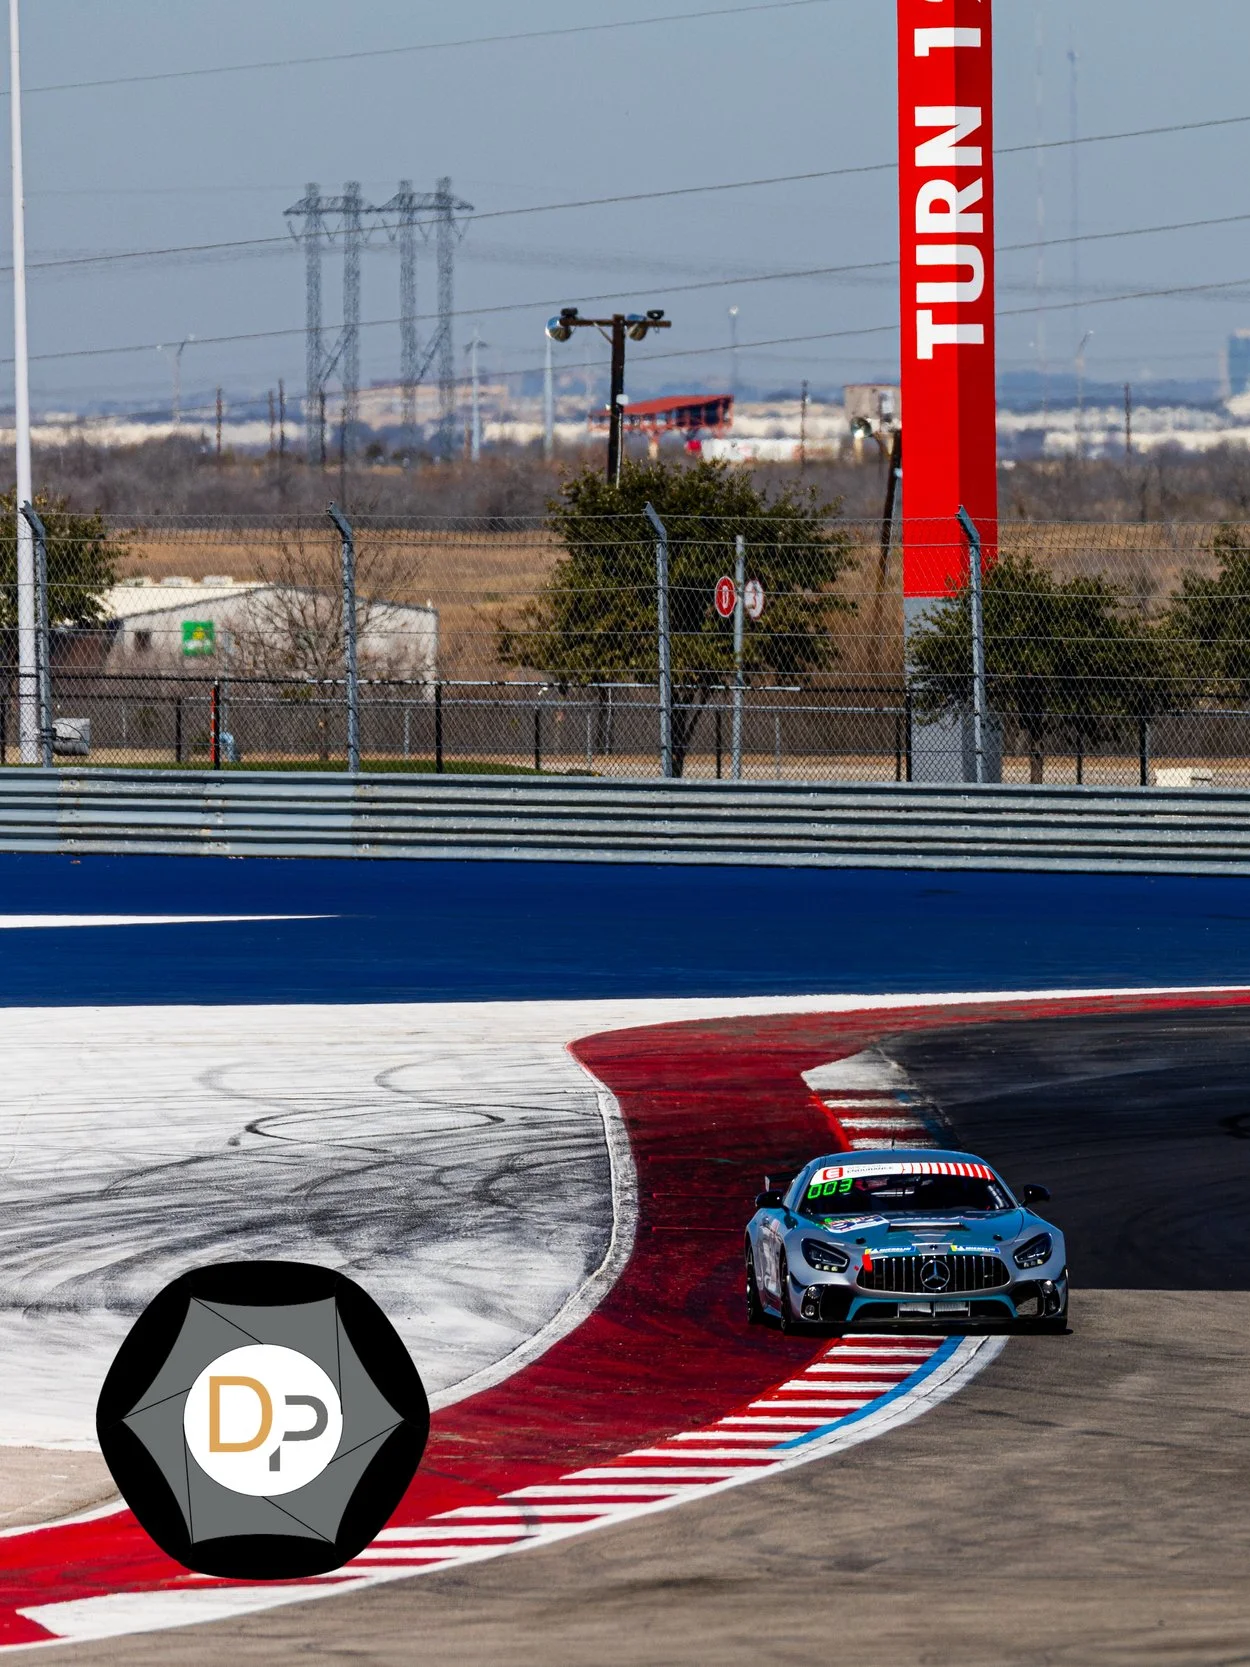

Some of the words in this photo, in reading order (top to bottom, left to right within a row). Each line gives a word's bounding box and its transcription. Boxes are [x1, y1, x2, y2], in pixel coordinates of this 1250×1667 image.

[914, 0, 982, 57] 1
[914, 105, 984, 360] TURN
[807, 1178, 853, 1199] 003
